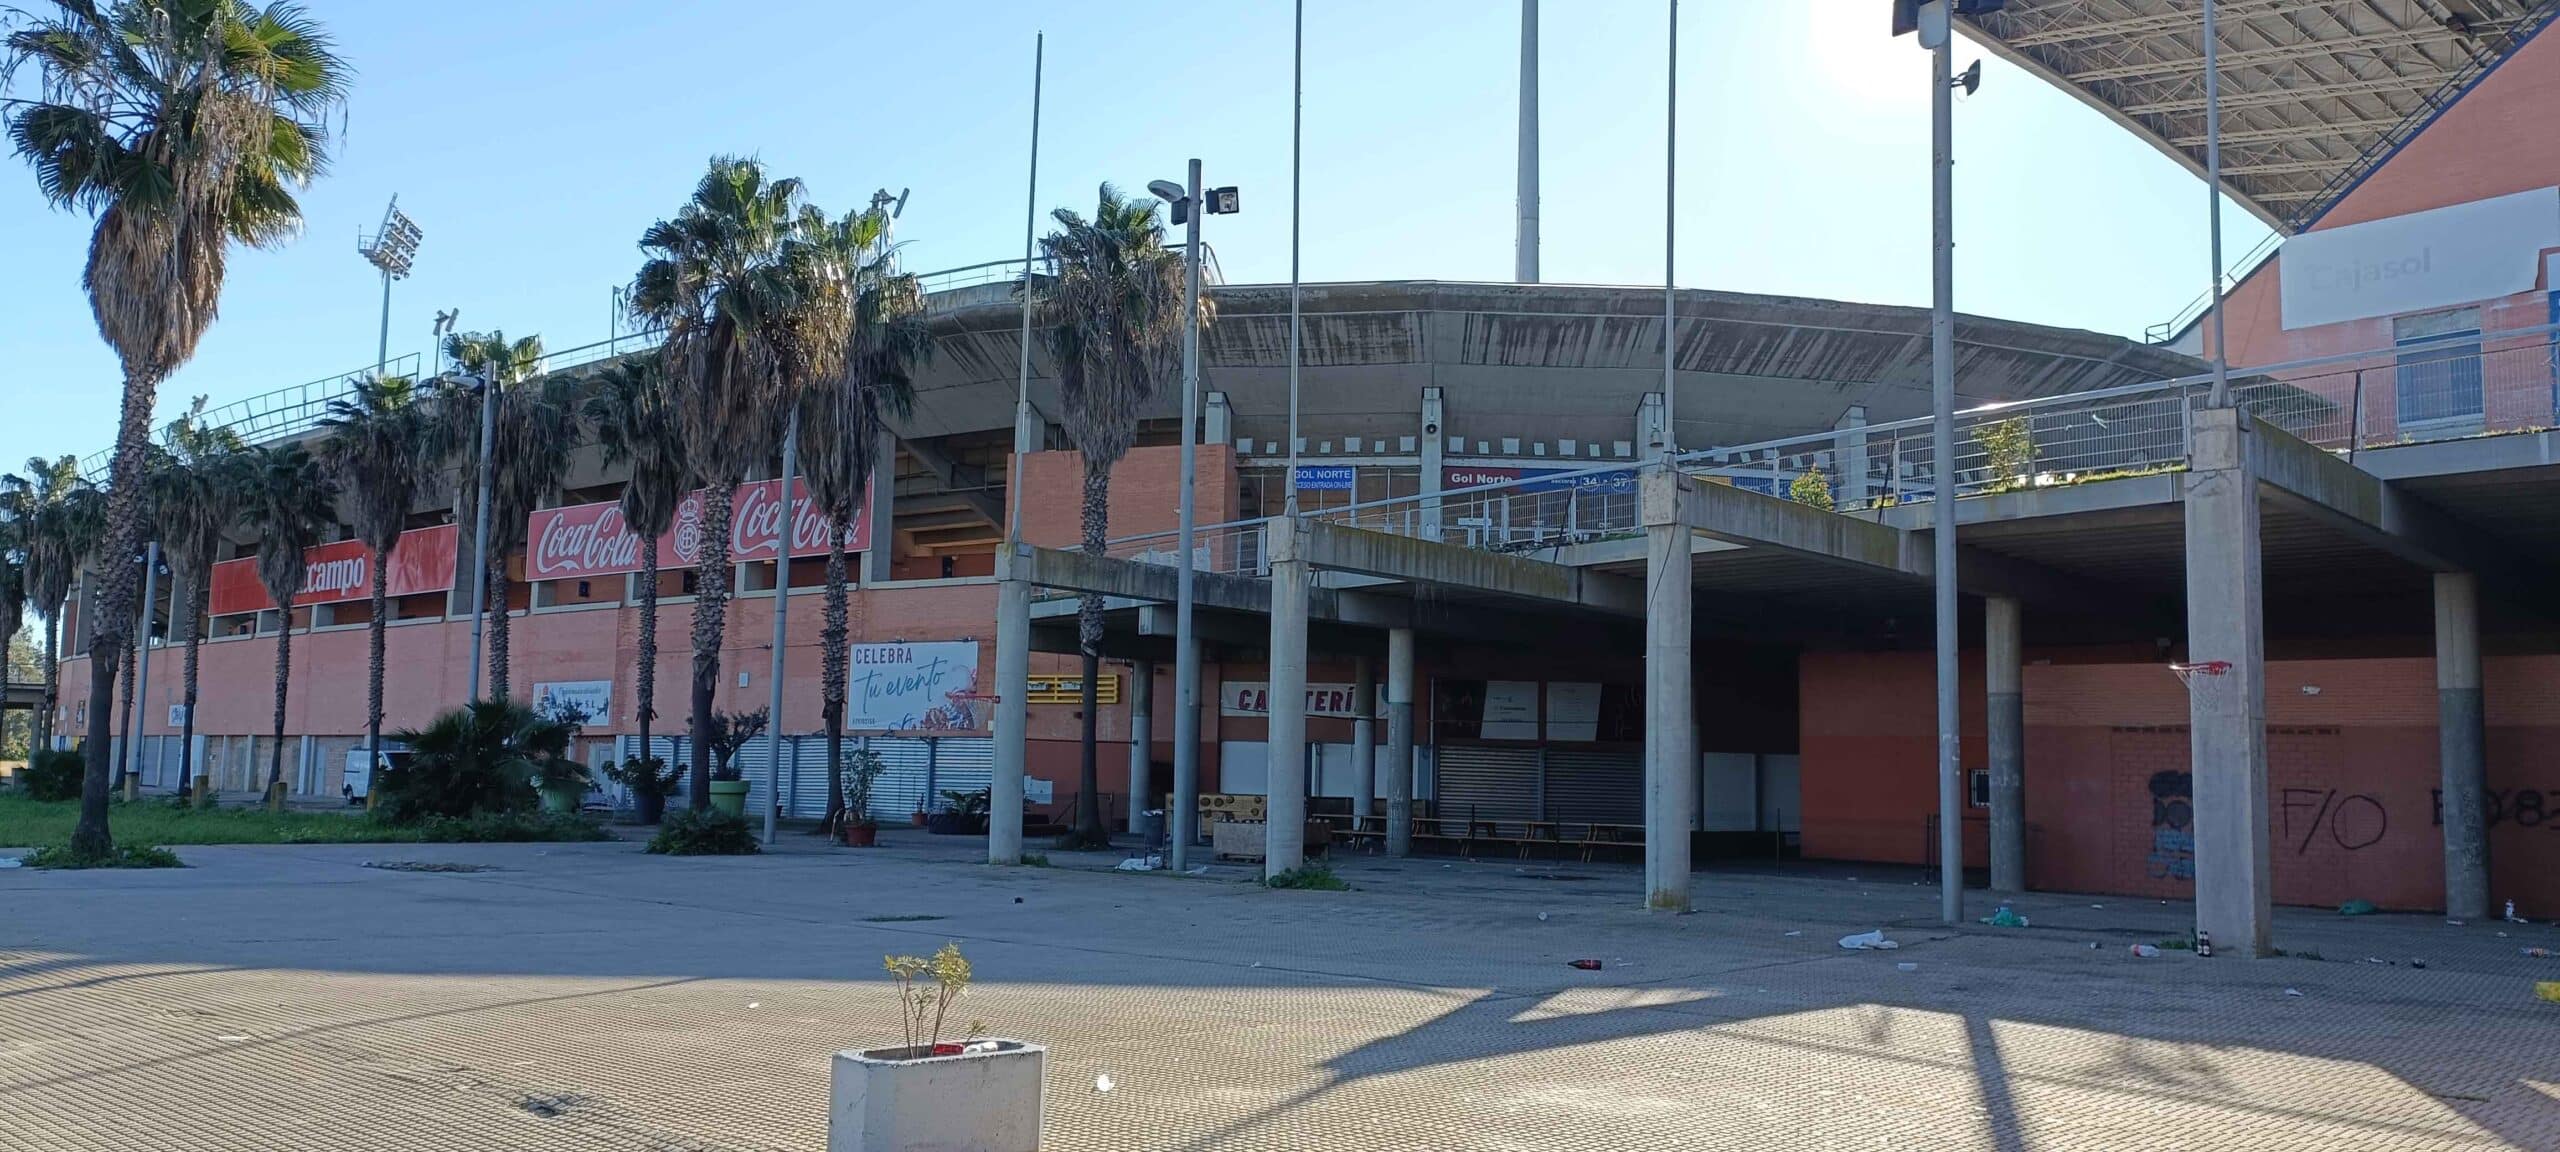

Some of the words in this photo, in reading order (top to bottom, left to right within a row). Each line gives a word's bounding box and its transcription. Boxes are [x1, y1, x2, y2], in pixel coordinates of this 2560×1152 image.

[2307, 247, 2432, 292] Cajasol
[1295, 470, 1314, 479] GOL
[1317, 470, 1351, 479] NORTE
[1451, 473, 1472, 484] Gol
[1477, 473, 1513, 485] Norte
[1582, 477, 1598, 486] 34
[1612, 477, 1628, 487] 37
[734, 487, 863, 555] Coca-Co
[536, 506, 639, 574] Coca-Cola
[856, 648, 913, 664] CELEBRA
[854, 669, 882, 714] tu
[887, 656, 948, 702] evento
[1238, 686, 1357, 712] CATERÍ
[2282, 788, 2387, 856] F/O
